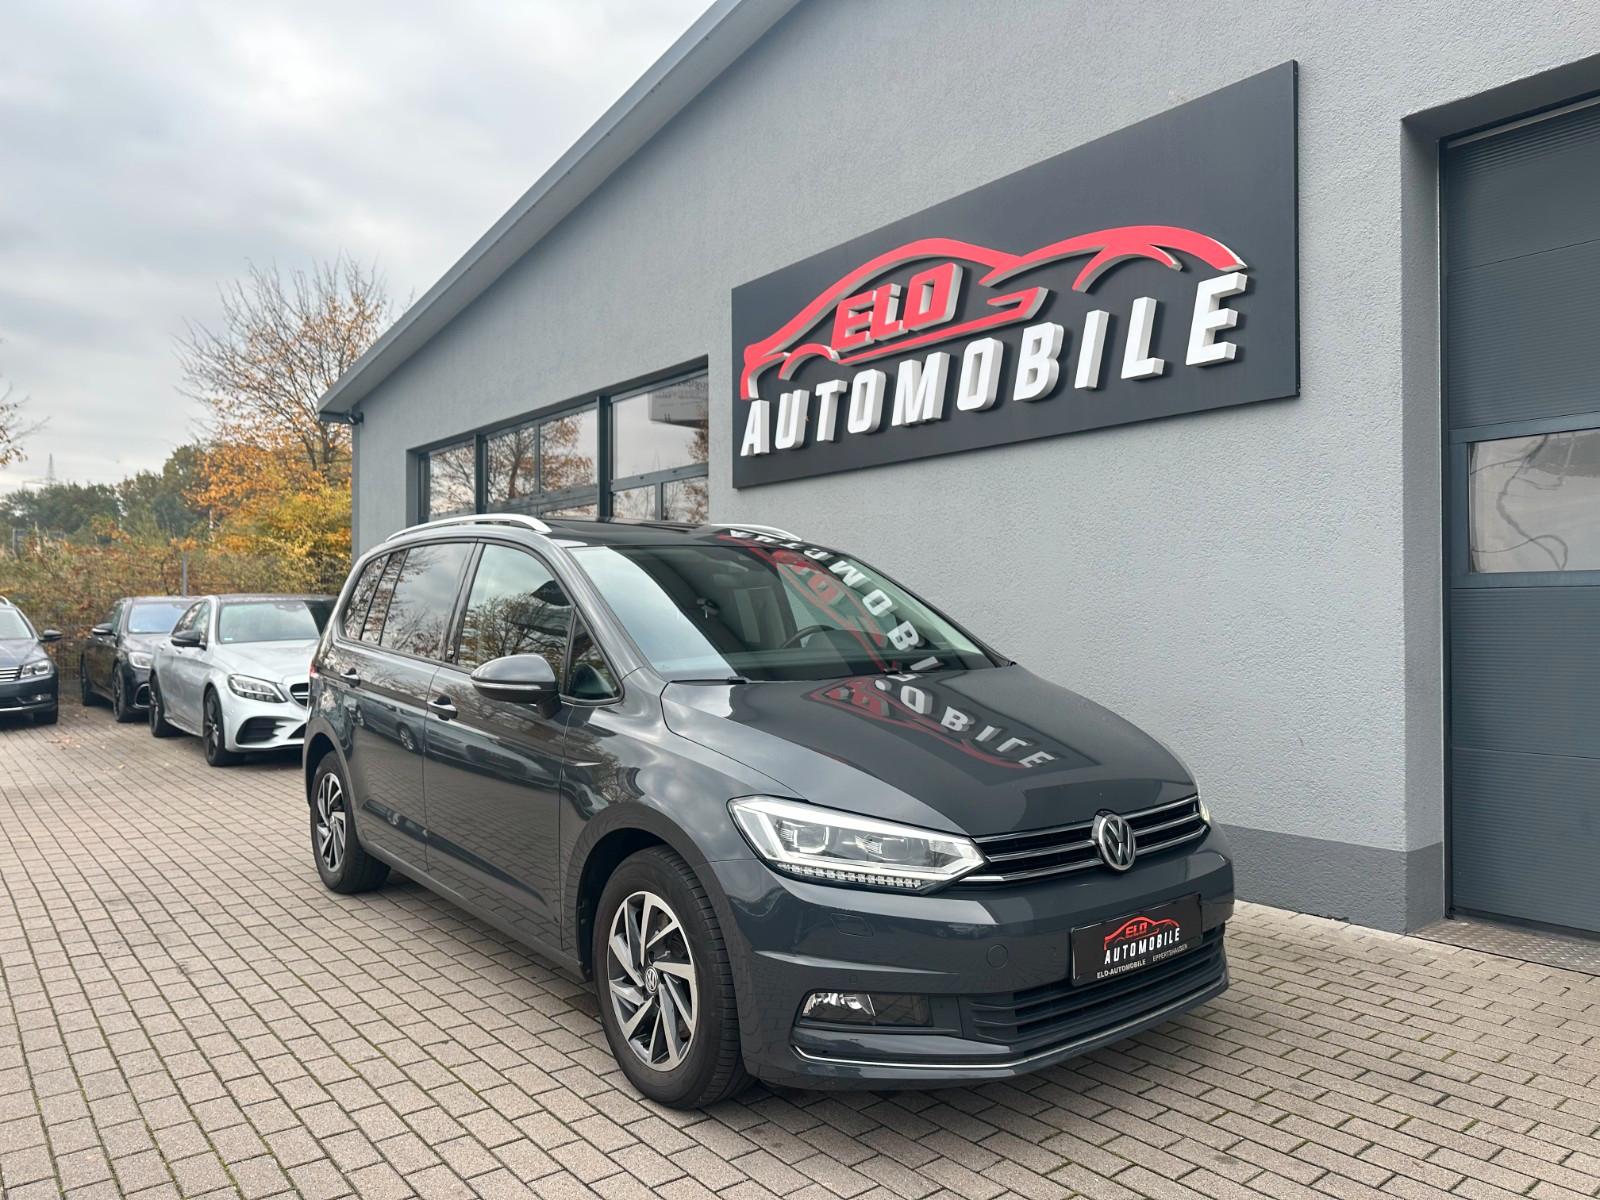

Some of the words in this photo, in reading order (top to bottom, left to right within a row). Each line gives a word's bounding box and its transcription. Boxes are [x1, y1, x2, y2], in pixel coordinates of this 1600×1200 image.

[830, 262, 963, 352] ELO
[740, 272, 1247, 457] AUTOMOBILE
[1104, 927, 1180, 965] AUTOMOBILE
[1125, 922, 1147, 937] ELO
[1096, 959, 1146, 979] ELO-AUTOMOBILE
